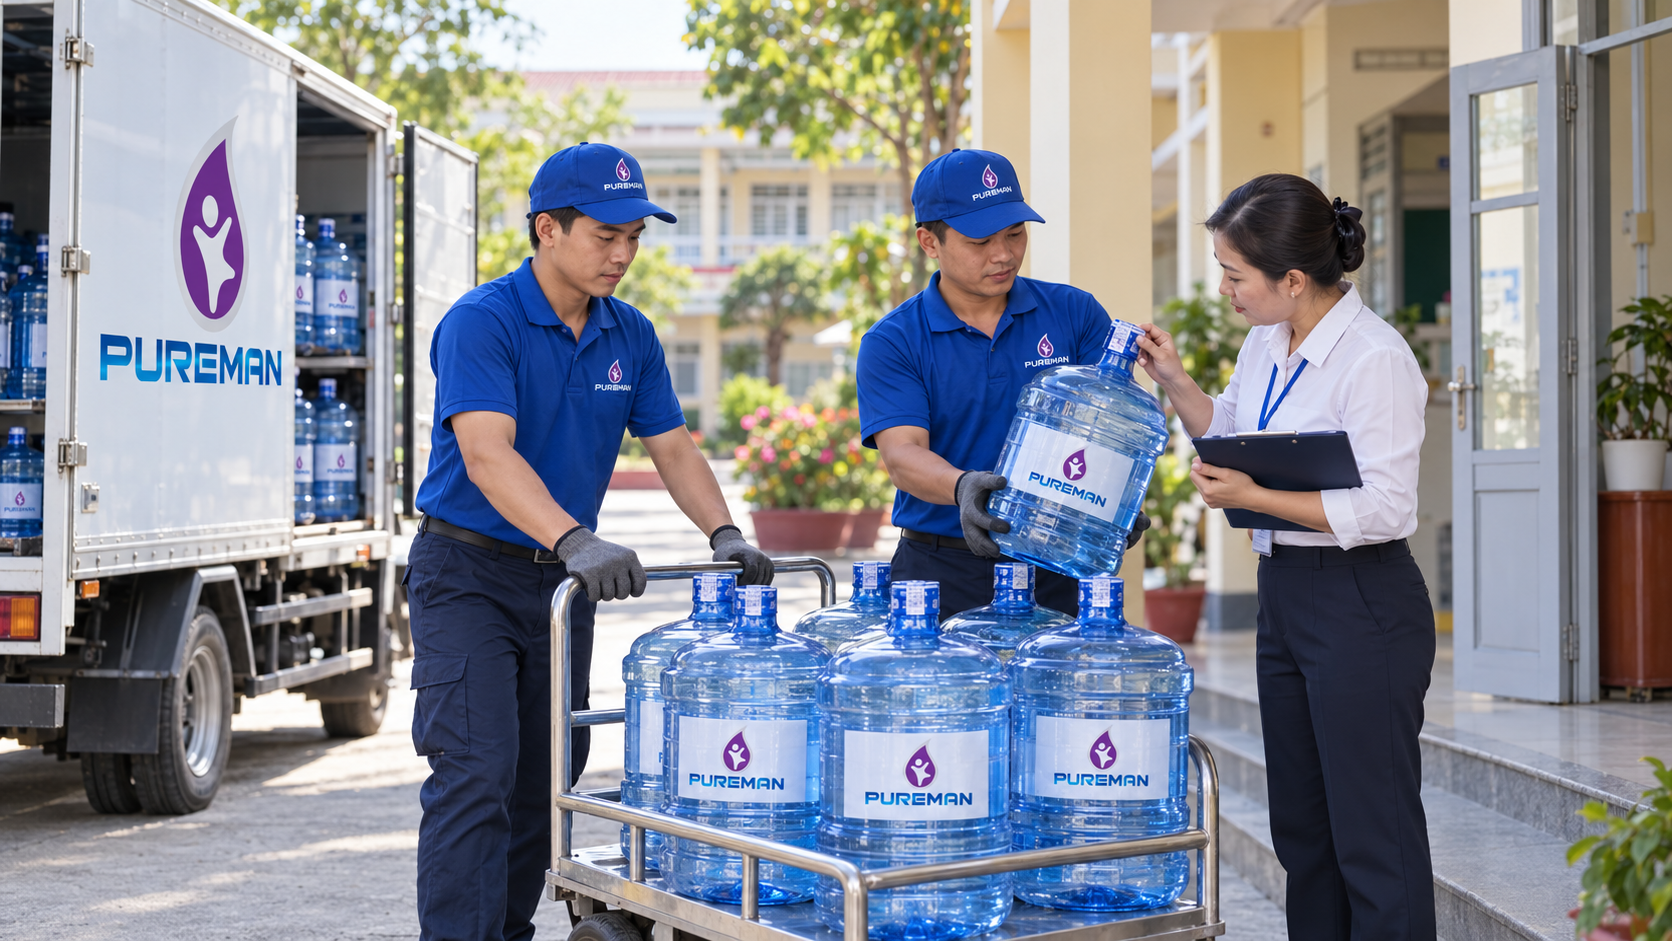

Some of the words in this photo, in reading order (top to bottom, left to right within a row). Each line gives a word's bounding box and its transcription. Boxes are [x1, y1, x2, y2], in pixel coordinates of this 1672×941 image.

[604, 182, 643, 191] PUREMAN
[972, 186, 1013, 201] PUREMAN
[100, 334, 282, 386] PUREMAN
[1025, 355, 1070, 369] PUREMAN
[594, 383, 632, 392] PUREMAN
[1028, 471, 1107, 508] PUREMAN
[689, 773, 785, 790] PUREMAN
[1053, 773, 1149, 787] PUREMAN
[865, 791, 973, 806] PUREMAN
